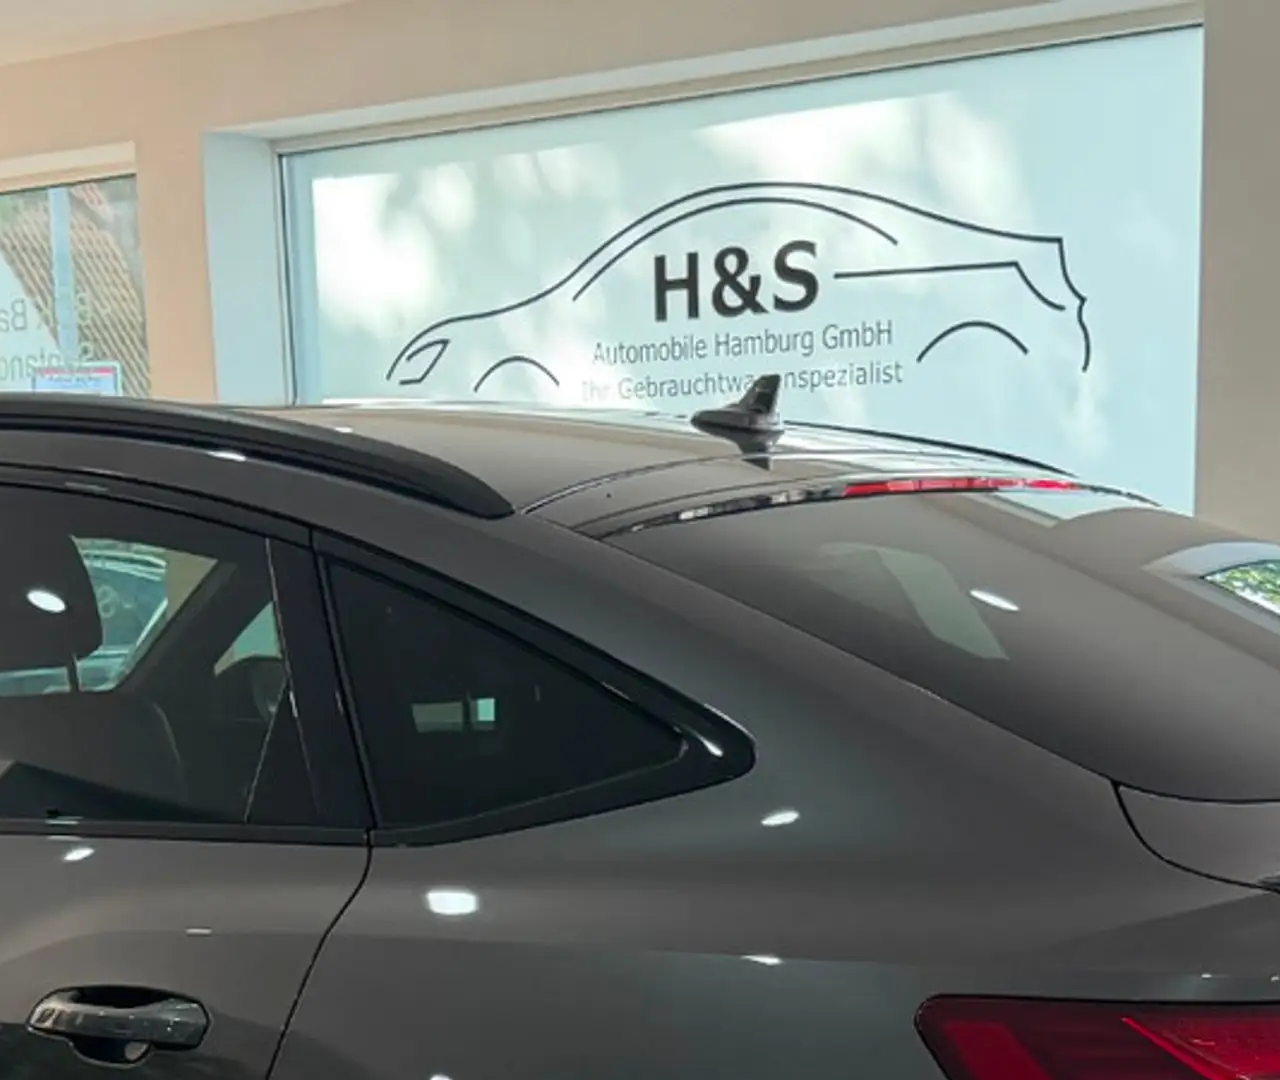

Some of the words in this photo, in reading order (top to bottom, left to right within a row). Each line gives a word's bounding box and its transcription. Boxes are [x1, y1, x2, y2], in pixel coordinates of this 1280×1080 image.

[654, 239, 820, 323] H&S
[592, 334, 708, 366] Automobile
[713, 329, 815, 358] Hamburg
[822, 319, 894, 350] GmbH
[618, 362, 904, 401] Gebrauchtwanspezialist
